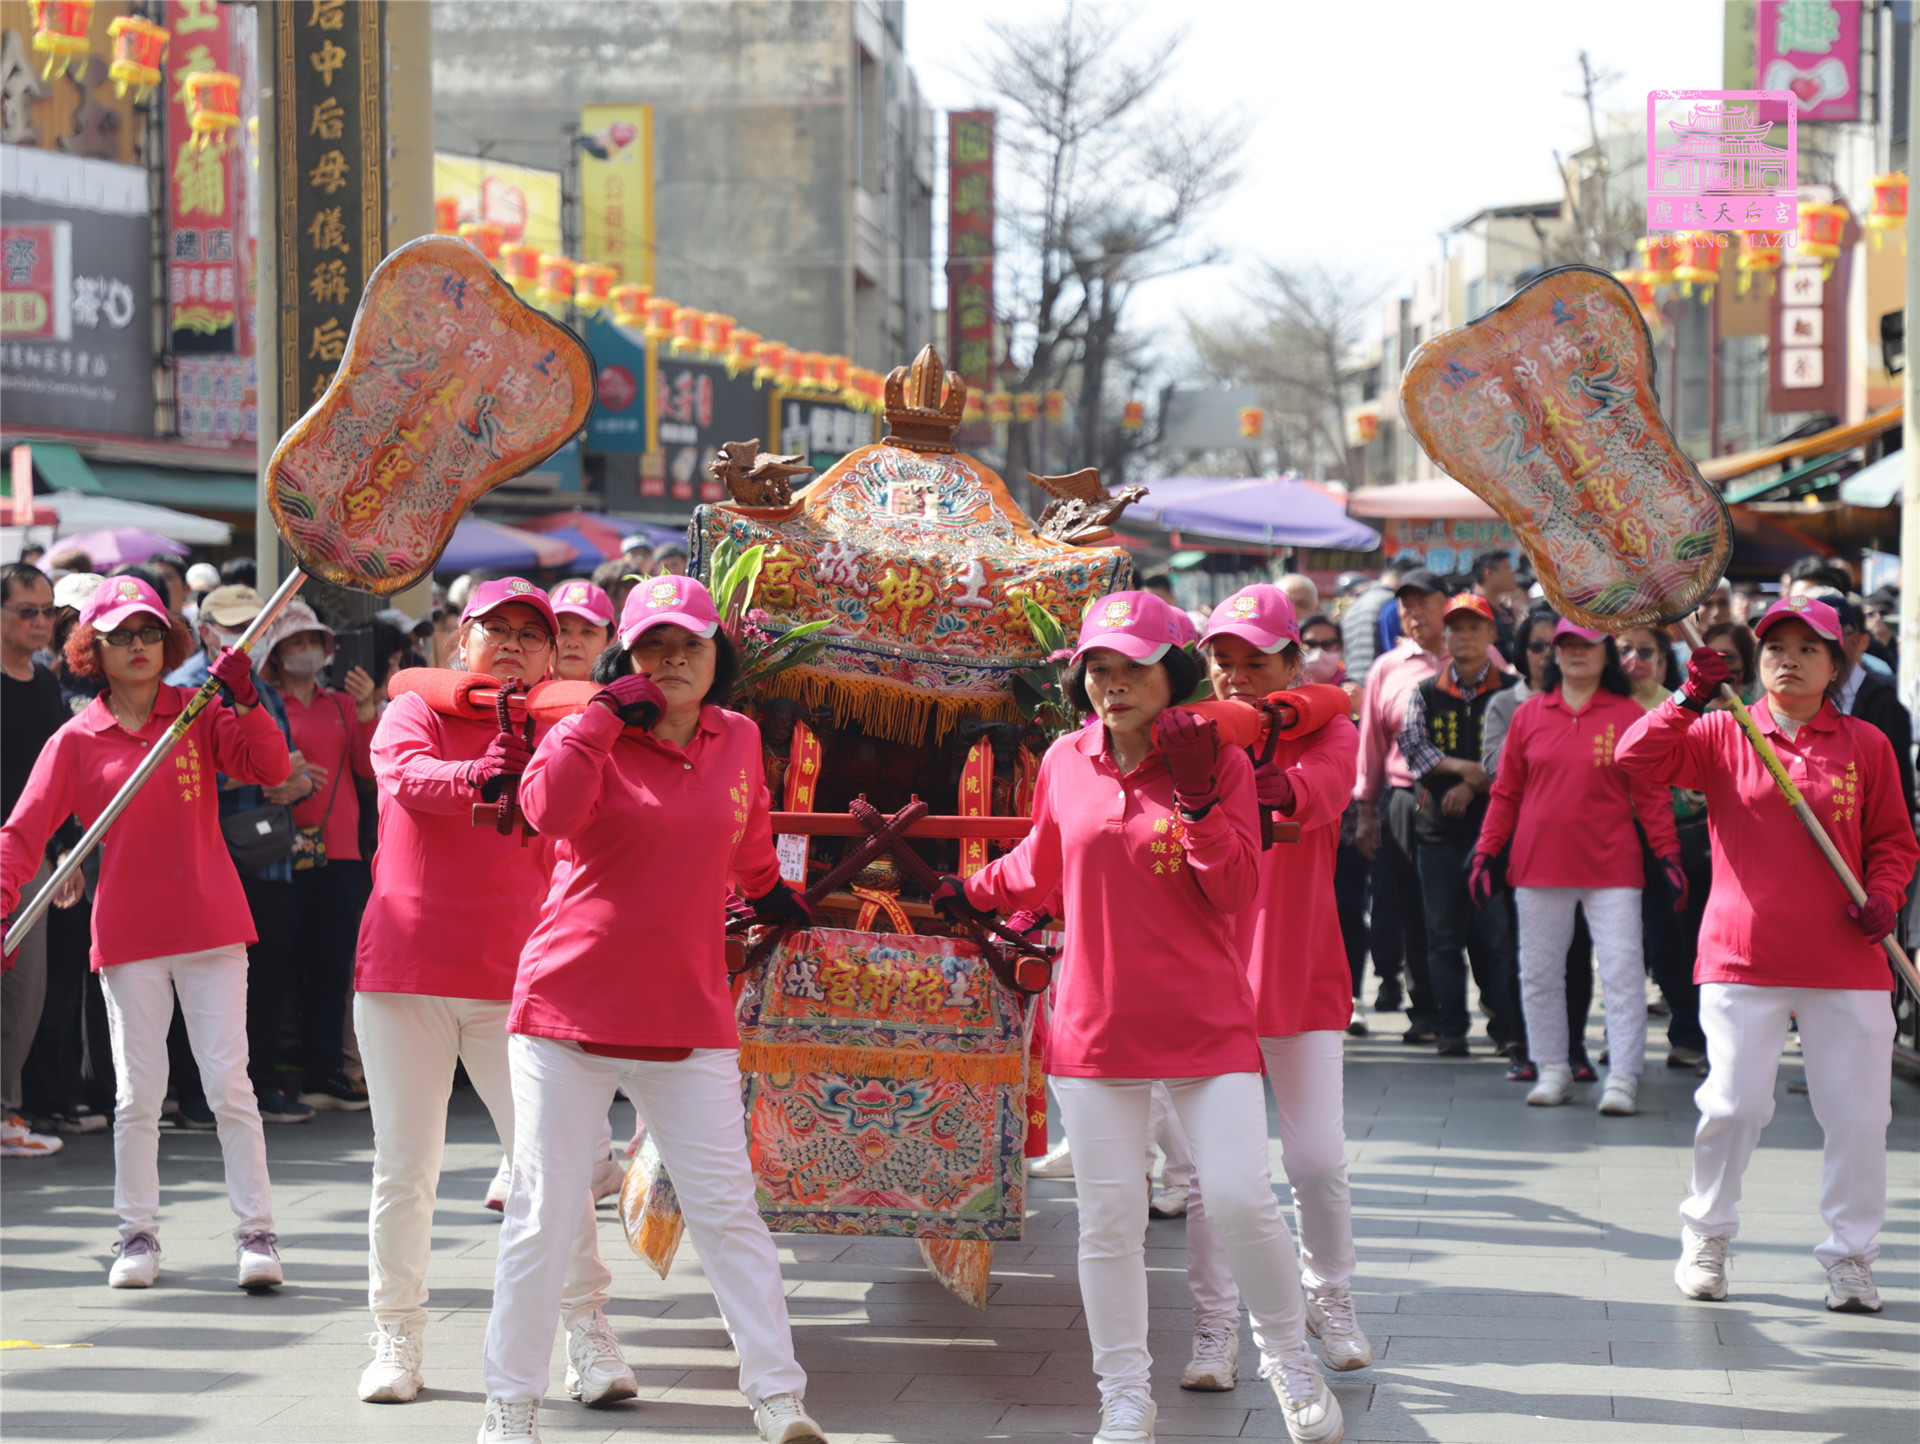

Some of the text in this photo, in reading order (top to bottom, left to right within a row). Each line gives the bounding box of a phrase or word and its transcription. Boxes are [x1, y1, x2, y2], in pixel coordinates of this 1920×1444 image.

[346, 377, 465, 521] 天上聖母
[1541, 396, 1647, 557] 天上聖母
